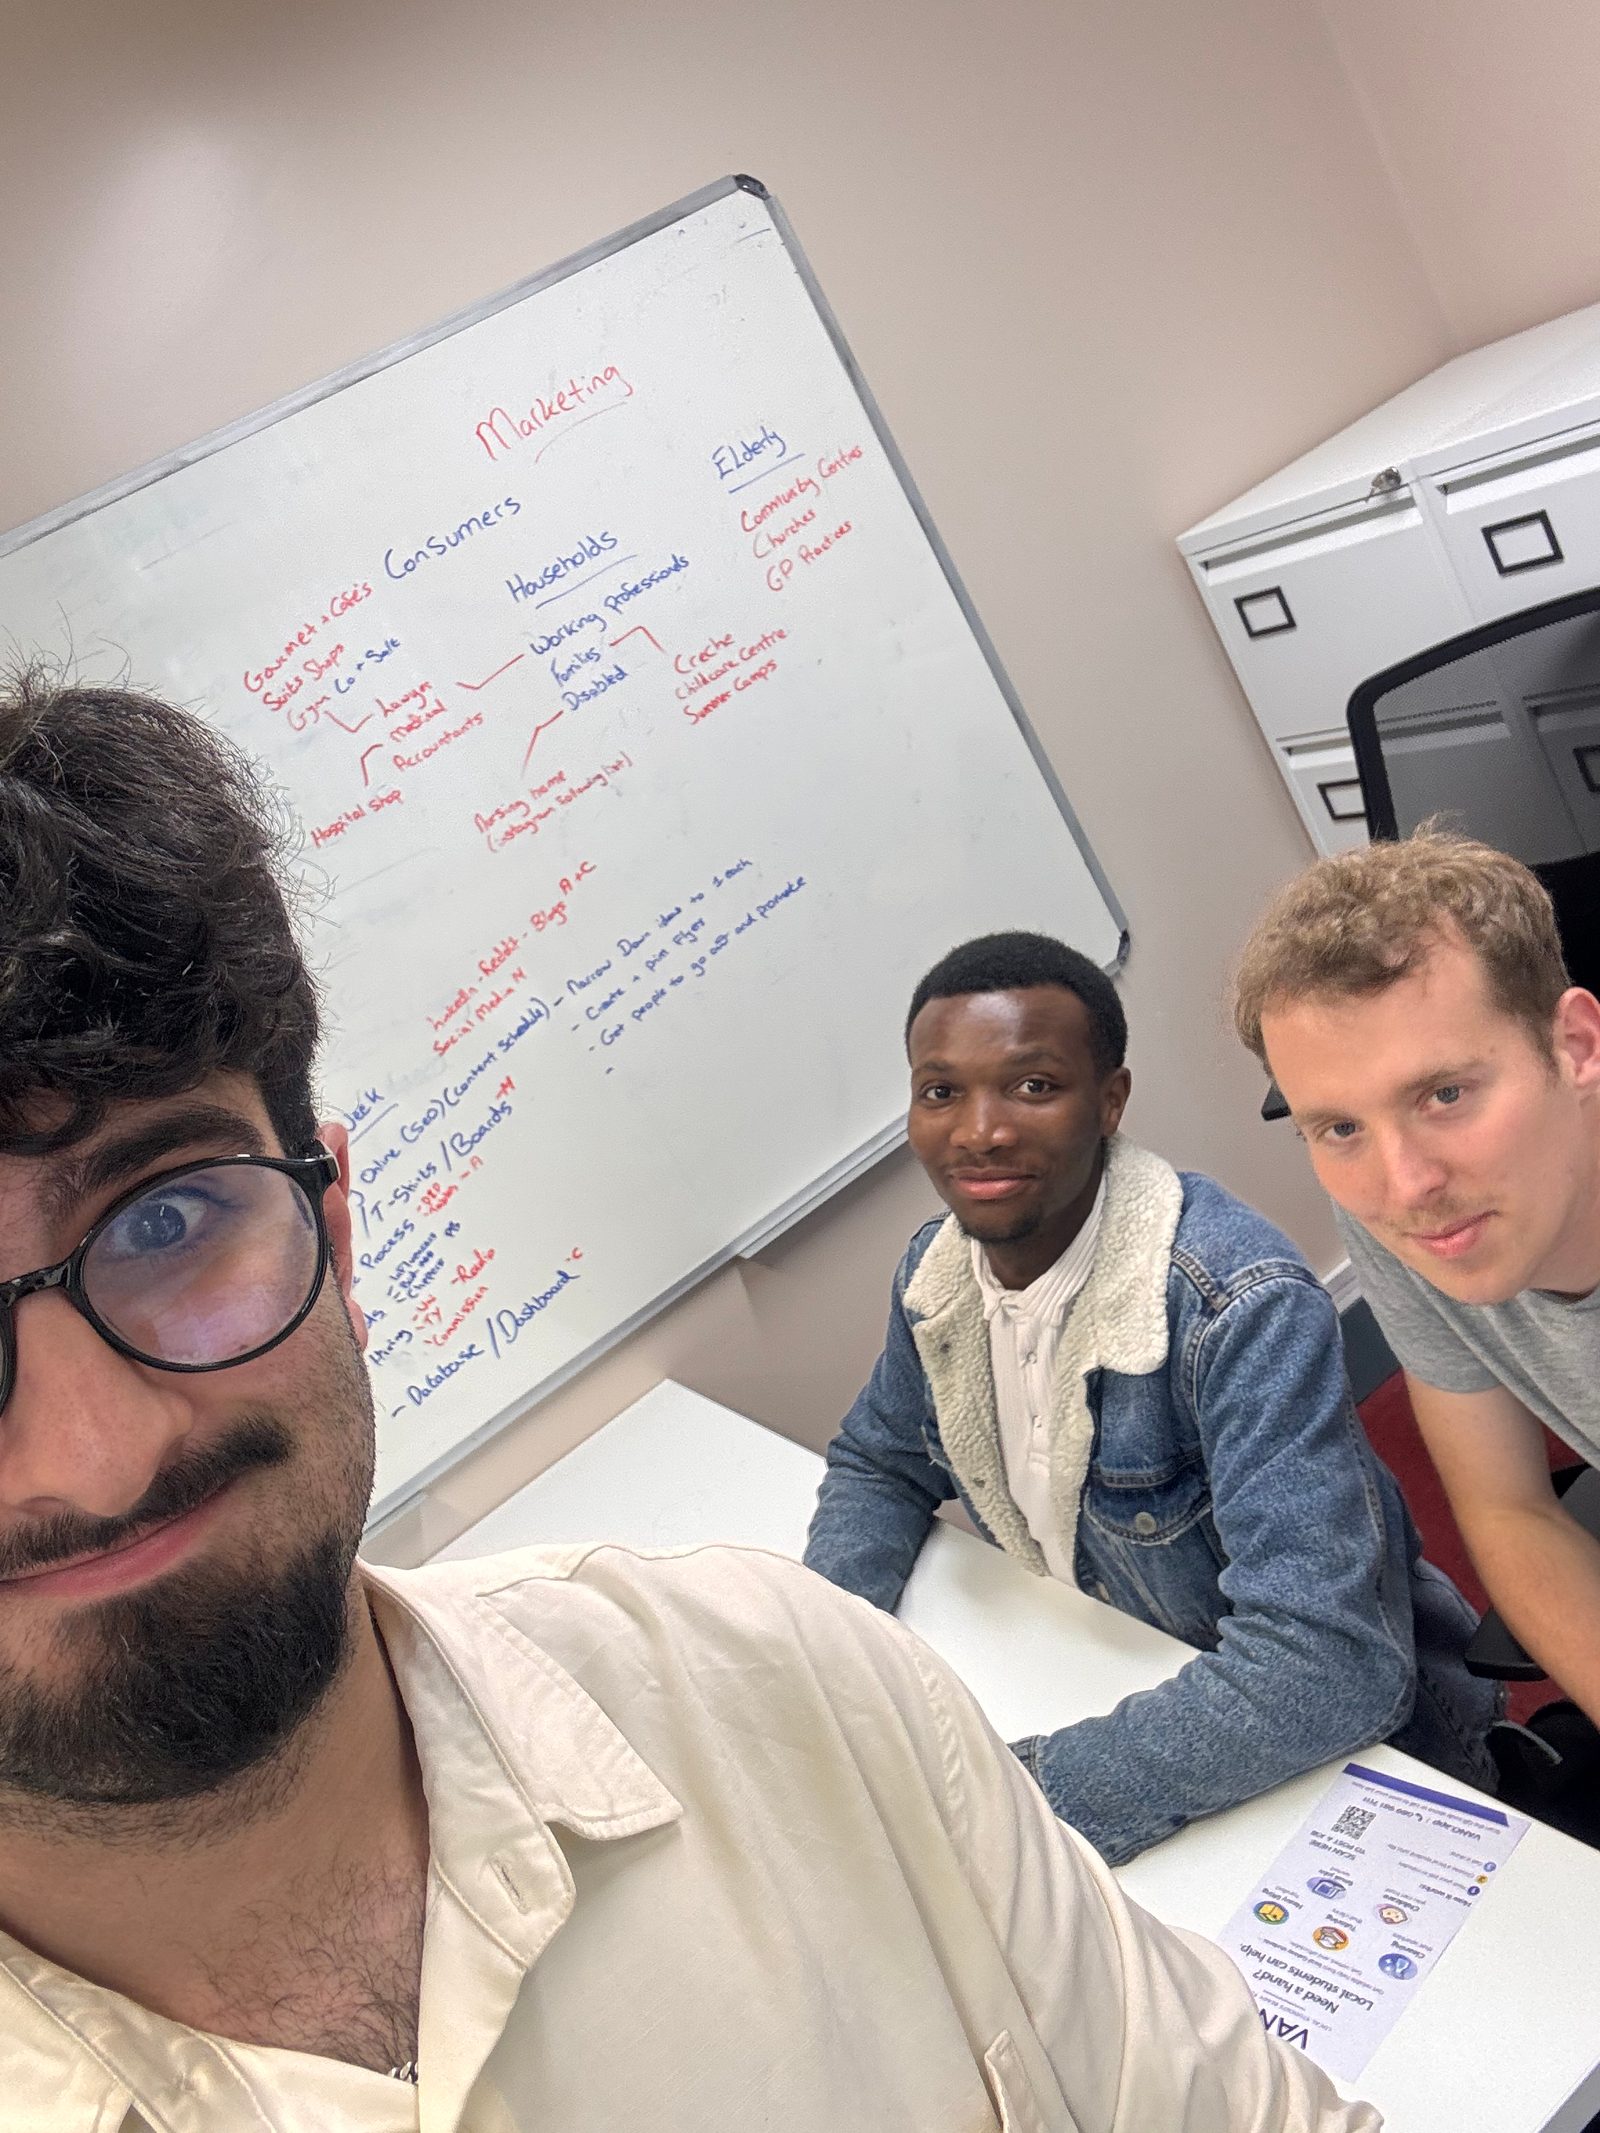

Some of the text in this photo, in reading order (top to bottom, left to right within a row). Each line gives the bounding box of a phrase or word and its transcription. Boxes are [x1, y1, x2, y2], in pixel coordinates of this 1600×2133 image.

[475, 366, 633, 461] Marketing
[741, 478, 820, 532] Community
[385, 497, 520, 579] Consumers
[753, 509, 816, 559] Churches
[506, 532, 617, 602] Households
[766, 521, 852, 592] GP Practices
[530, 614, 607, 655] Working
[674, 634, 734, 674] Creche
[262, 644, 344, 711] Suits Shops
[550, 647, 601, 687] Families
[676, 629, 787, 700] Childcare Centre
[562, 664, 628, 711] Disabled
[683, 660, 777, 725] Summer Camps
[287, 695, 331, 731] Gym
[393, 712, 483, 771] Accountants
[311, 804, 366, 848] Hospital
[530, 901, 567, 932] Blogs
[566, 960, 611, 995] Narrow
[617, 932, 650, 957] Down
[690, 893, 704, 903] to
[433, 1020, 474, 1057] Social
[475, 987, 514, 1021] Media
[601, 1024, 624, 1046] Get
[632, 988, 666, 1021] people
[690, 956, 706, 977] go
[360, 1149, 401, 1184] Online
[360, 1219, 414, 1269] Process
[407, 1344, 484, 1406] Database
[1309, 1840, 1356, 1860] SCAN HERE
[1310, 1830, 1326, 1838] JOB
[1333, 1839, 1354, 1850] POST
[1354, 1847, 1365, 1855] TO
[1325, 1914, 1356, 1932] Tutoring
[1240, 1945, 1266, 1962] help.
[1267, 1956, 1288, 1969] can
[1252, 1969, 1339, 2014] Need a hand?
[1288, 1966, 1339, 1993] students
[1339, 1989, 1374, 2011] Local
[1259, 2009, 1308, 2050] VAN
